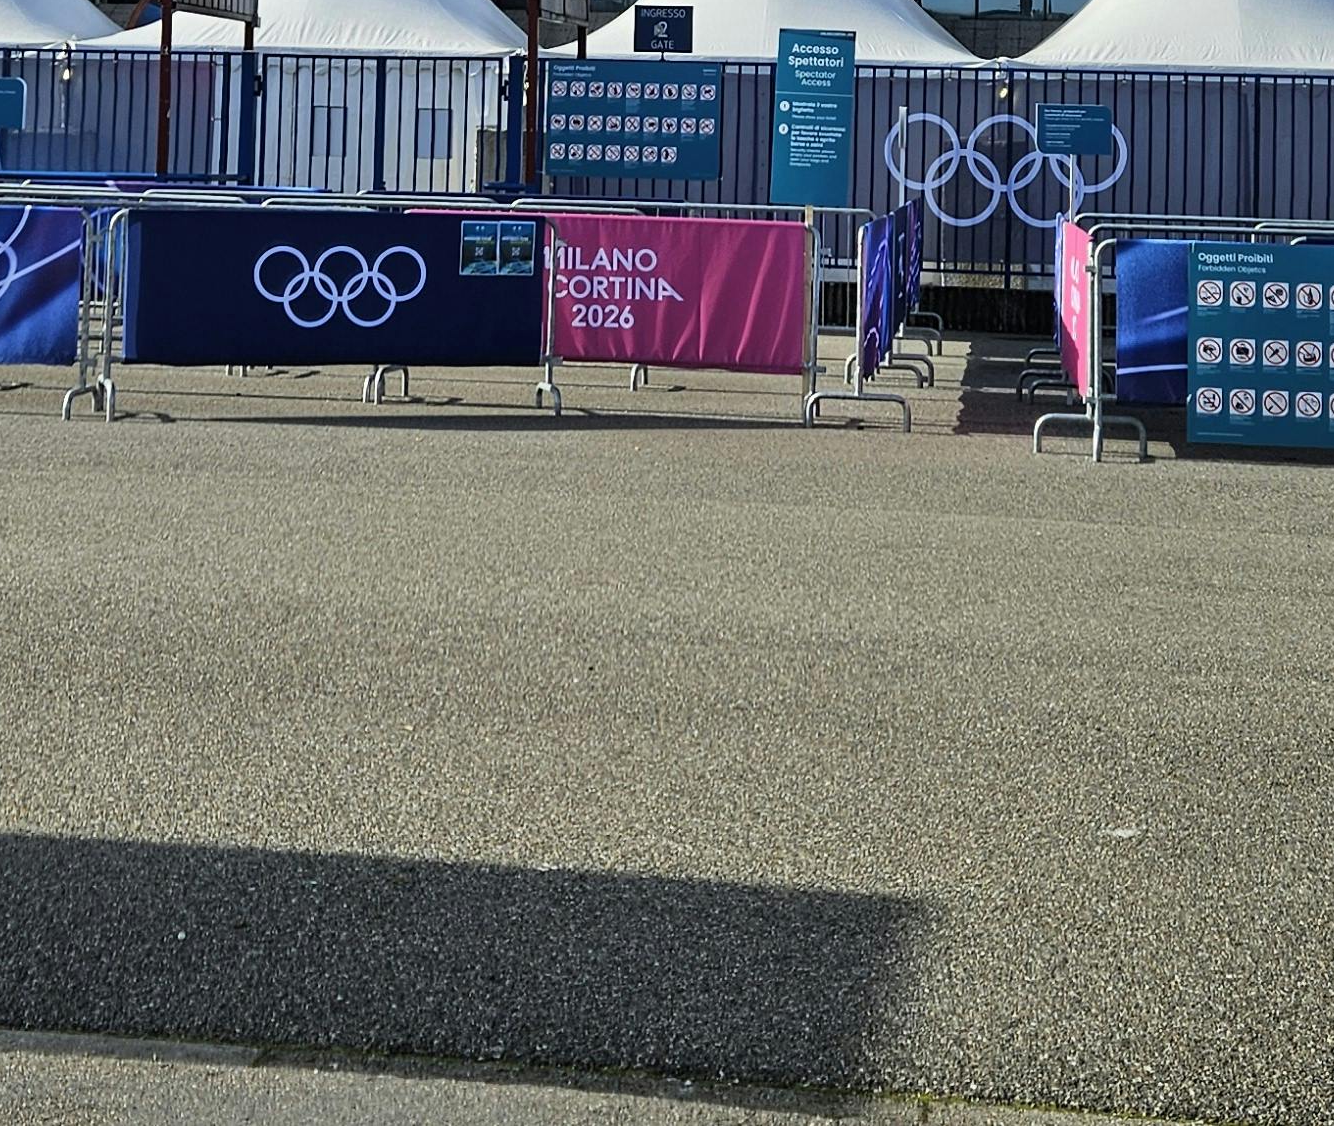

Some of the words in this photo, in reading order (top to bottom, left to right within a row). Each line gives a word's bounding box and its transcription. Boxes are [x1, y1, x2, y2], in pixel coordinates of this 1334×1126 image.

[640, 8, 686, 18] INGRESSO
[650, 39, 675, 49] GATE
[791, 43, 839, 54] Accesso
[788, 55, 844, 68] Spettatori
[1198, 252, 1236, 264] Oggetti
[571, 304, 635, 329] 2026
